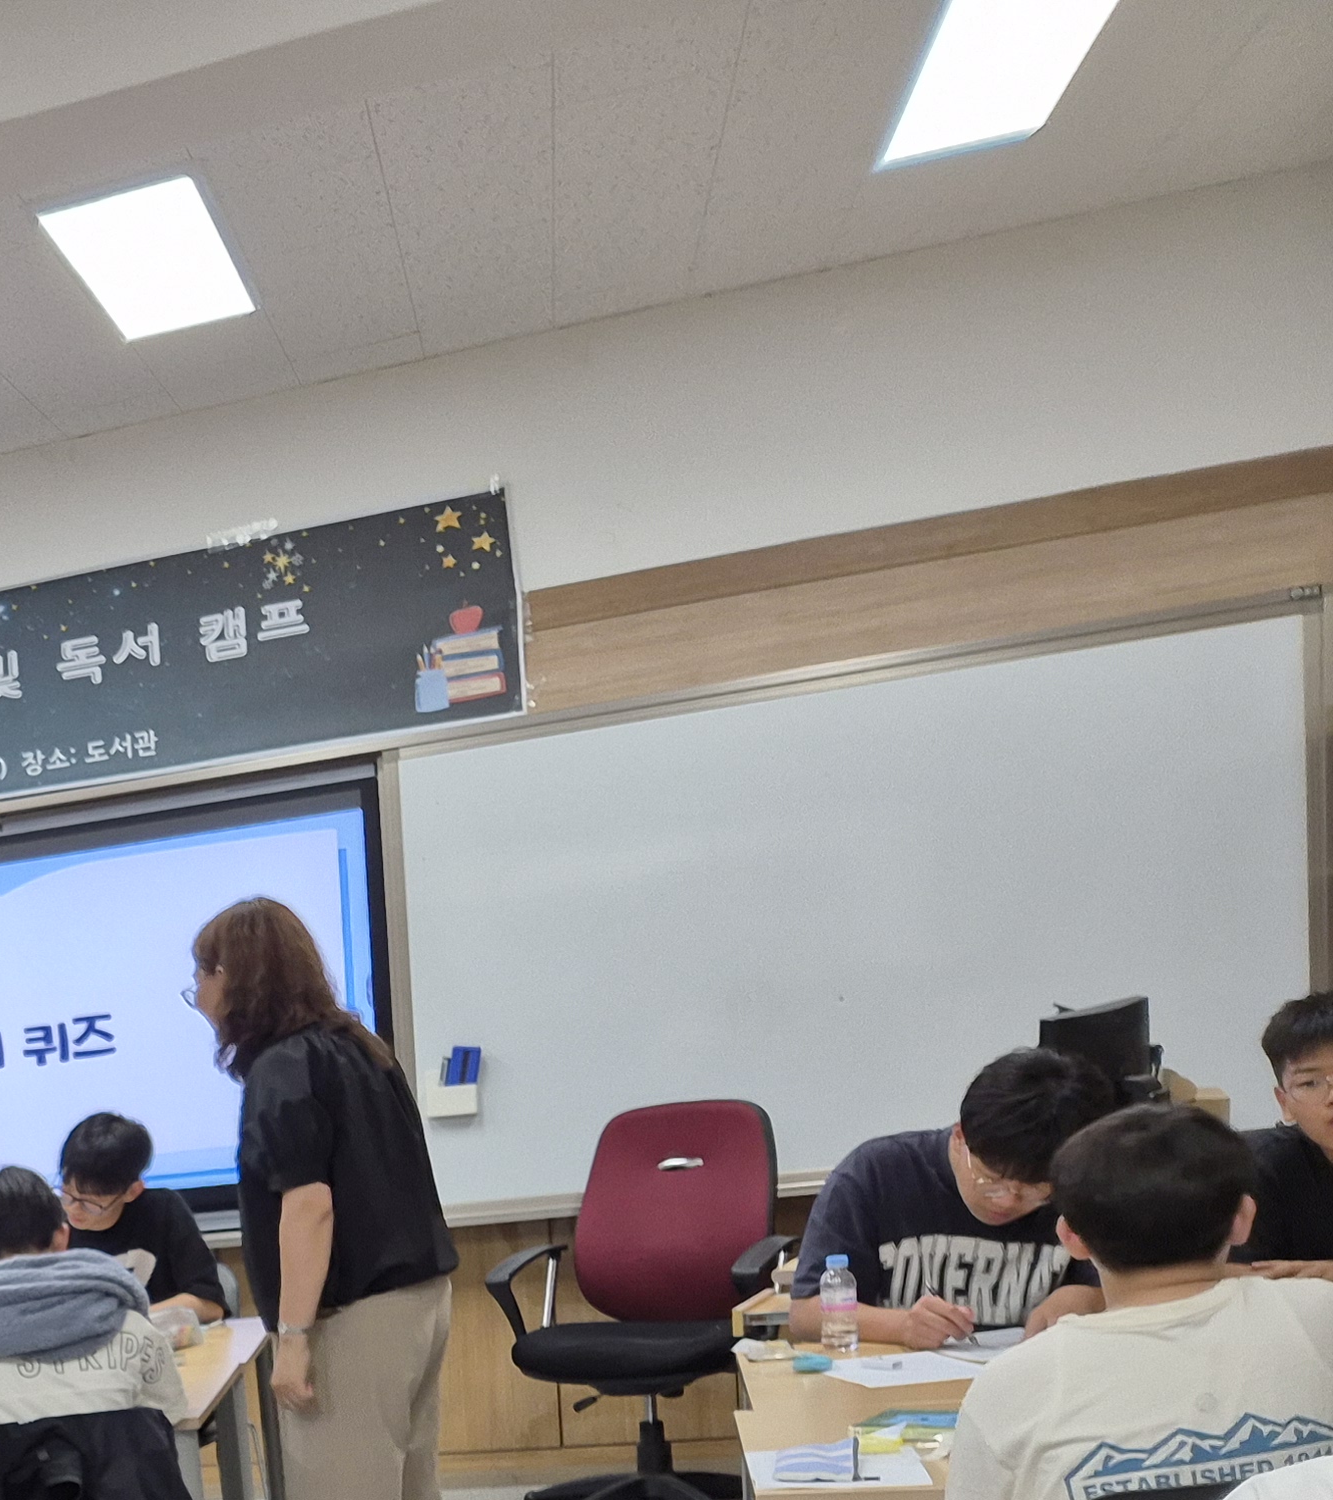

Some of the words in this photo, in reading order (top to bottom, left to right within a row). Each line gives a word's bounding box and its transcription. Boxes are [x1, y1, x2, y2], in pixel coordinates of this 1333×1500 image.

[56, 621, 162, 684] 독서
[198, 598, 311, 663] 캠프
[21, 746, 77, 777] 장소:
[84, 729, 159, 764] 도서관
[22, 1012, 118, 1068] 퀴즈
